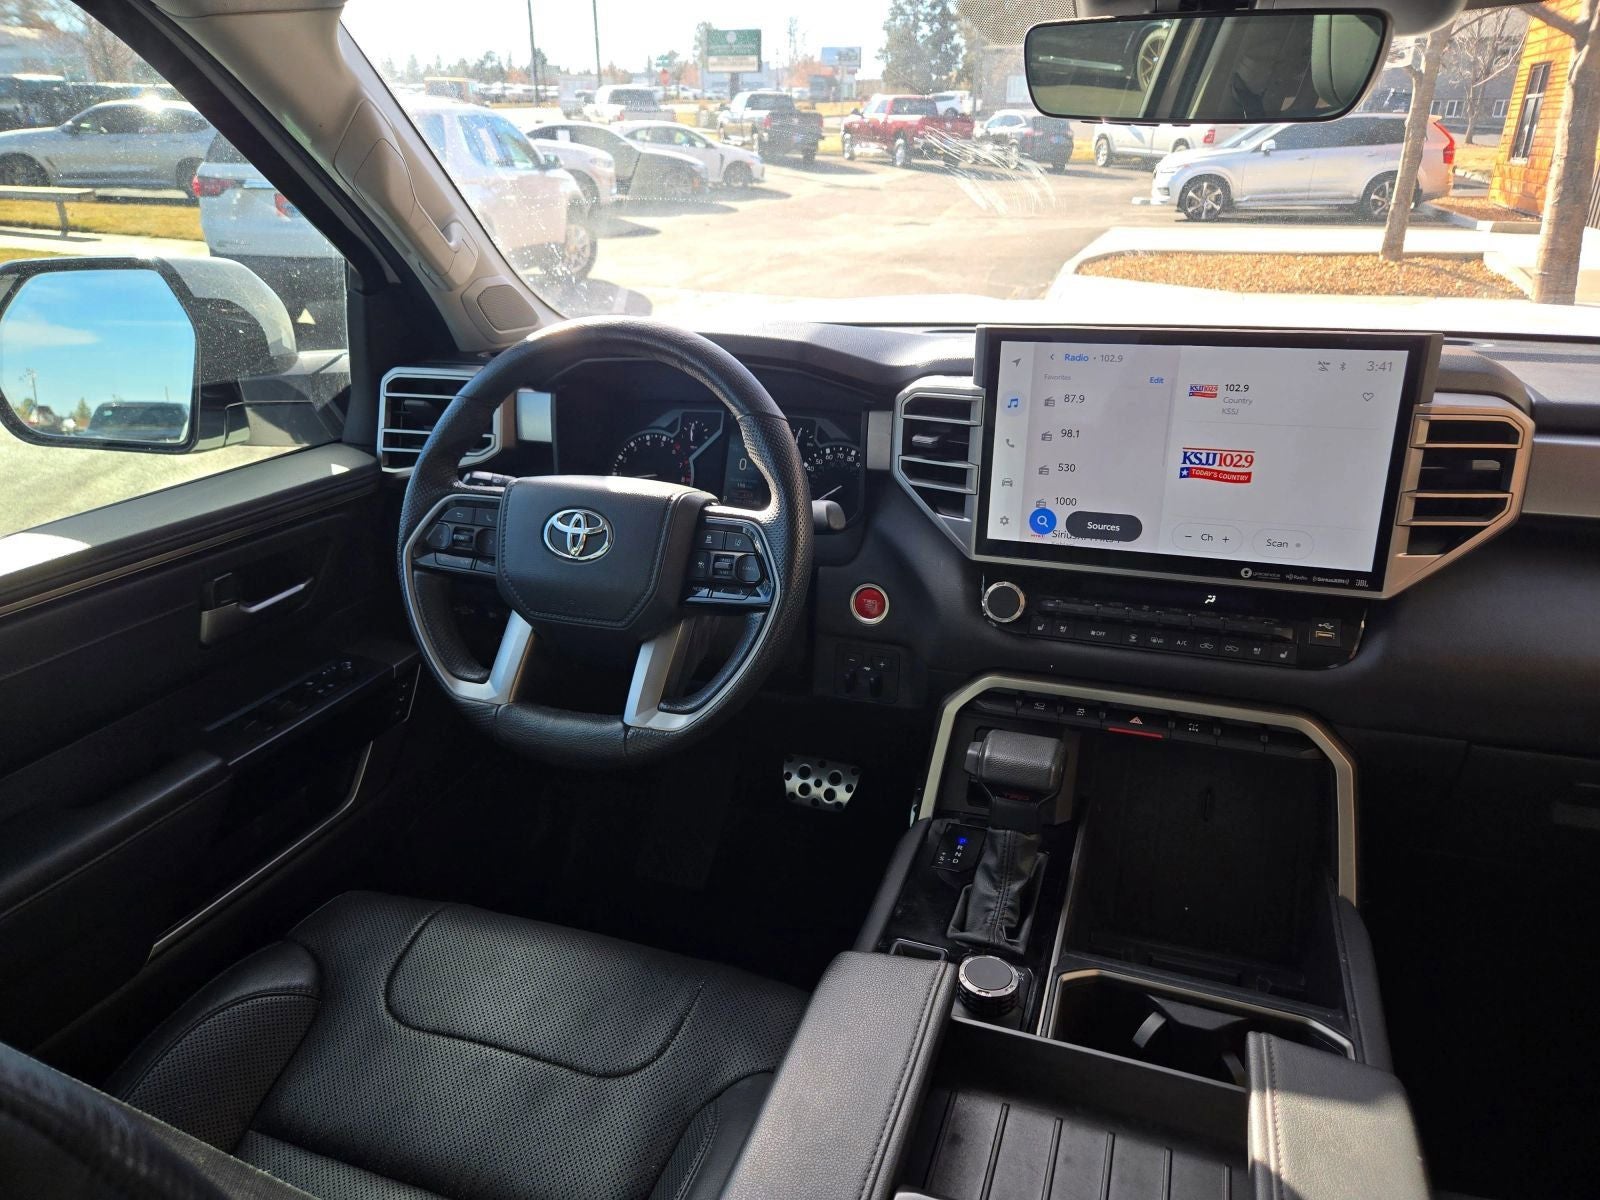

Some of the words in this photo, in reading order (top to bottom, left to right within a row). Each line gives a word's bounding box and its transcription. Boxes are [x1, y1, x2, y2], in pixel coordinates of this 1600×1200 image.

[1064, 353, 1089, 362] Radio
[1100, 354, 1123, 363] 102.9
[1366, 360, 1393, 372] 3:41
[1044, 373, 1072, 381] Favorites
[1149, 376, 1164, 384] Edit
[1225, 383, 1250, 393] 102.9
[1063, 394, 1085, 404] 87.9
[1222, 396, 1253, 406] Country
[1060, 428, 1080, 438] 98.1
[739, 458, 747, 471] 0
[1057, 462, 1076, 473] 530
[1191, 468, 1218, 478] TODAY'S
[1218, 472, 1249, 481] COUNTRY
[1055, 496, 1077, 507] 1000
[1086, 520, 1121, 532] Sources
[1200, 532, 1214, 542] Ch
[1266, 538, 1289, 549] Scan
